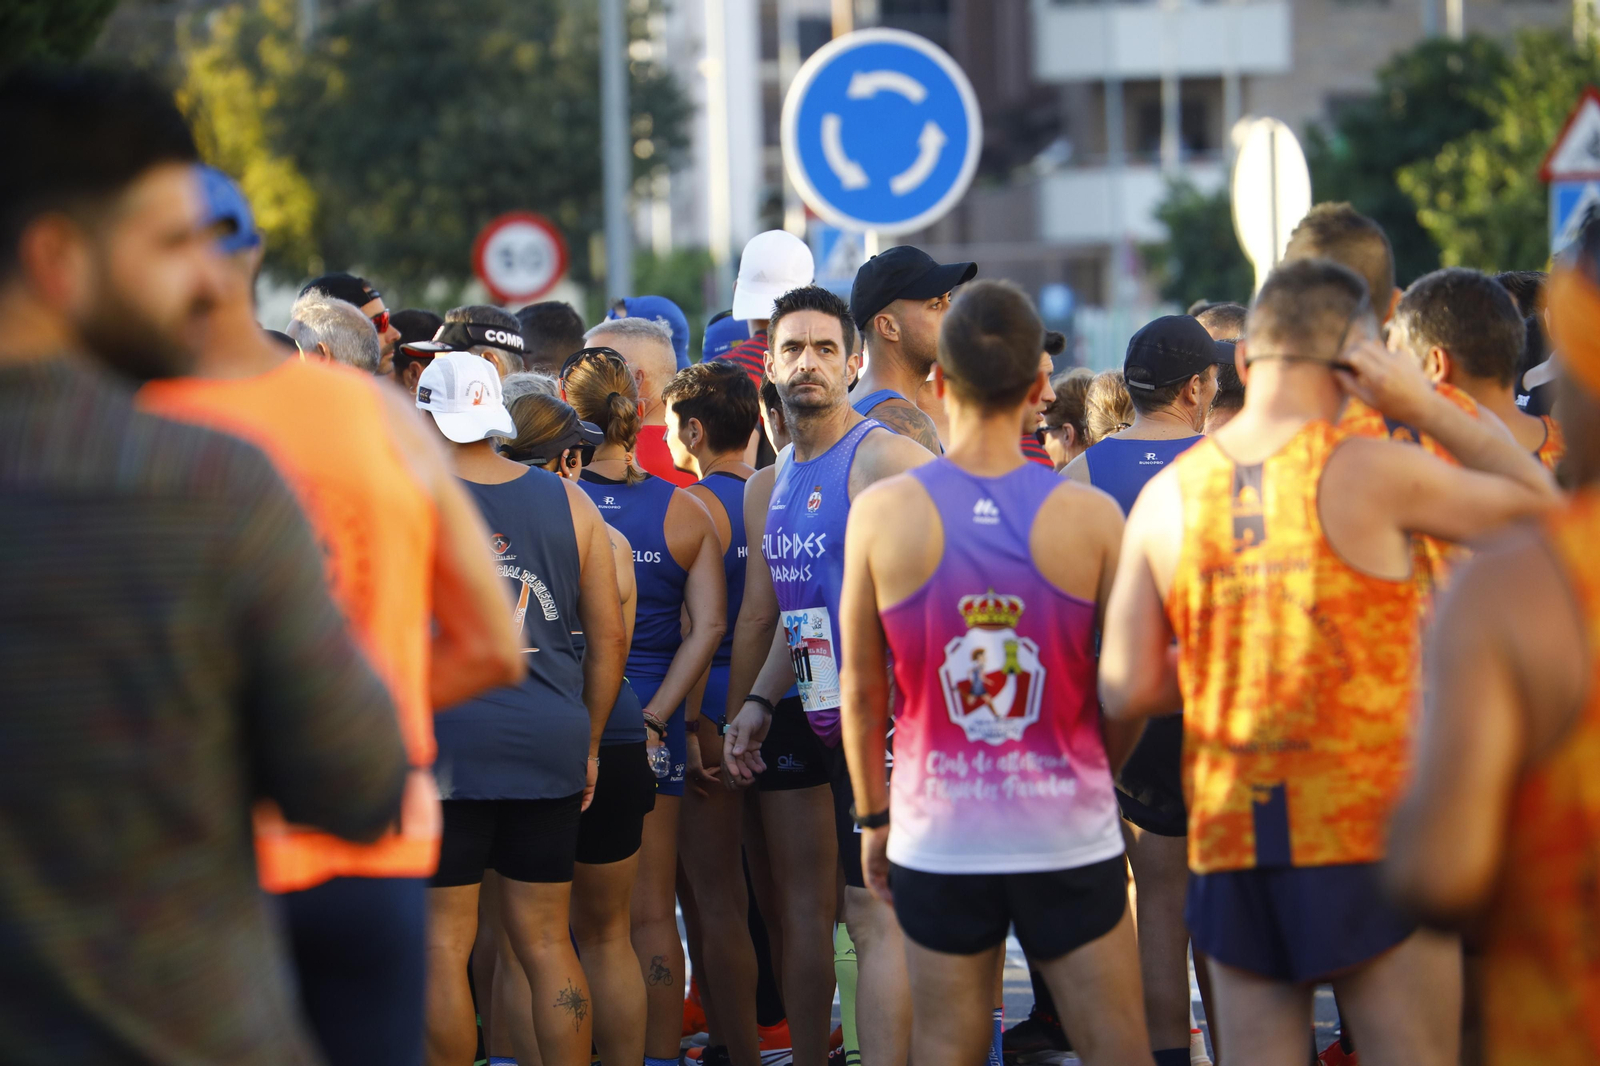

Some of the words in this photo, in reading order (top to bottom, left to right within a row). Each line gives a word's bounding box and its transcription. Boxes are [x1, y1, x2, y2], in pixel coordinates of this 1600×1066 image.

[484, 329, 524, 351] COMP
[529, 579, 560, 622] ATLETISMO
[790, 647, 812, 682] 01
